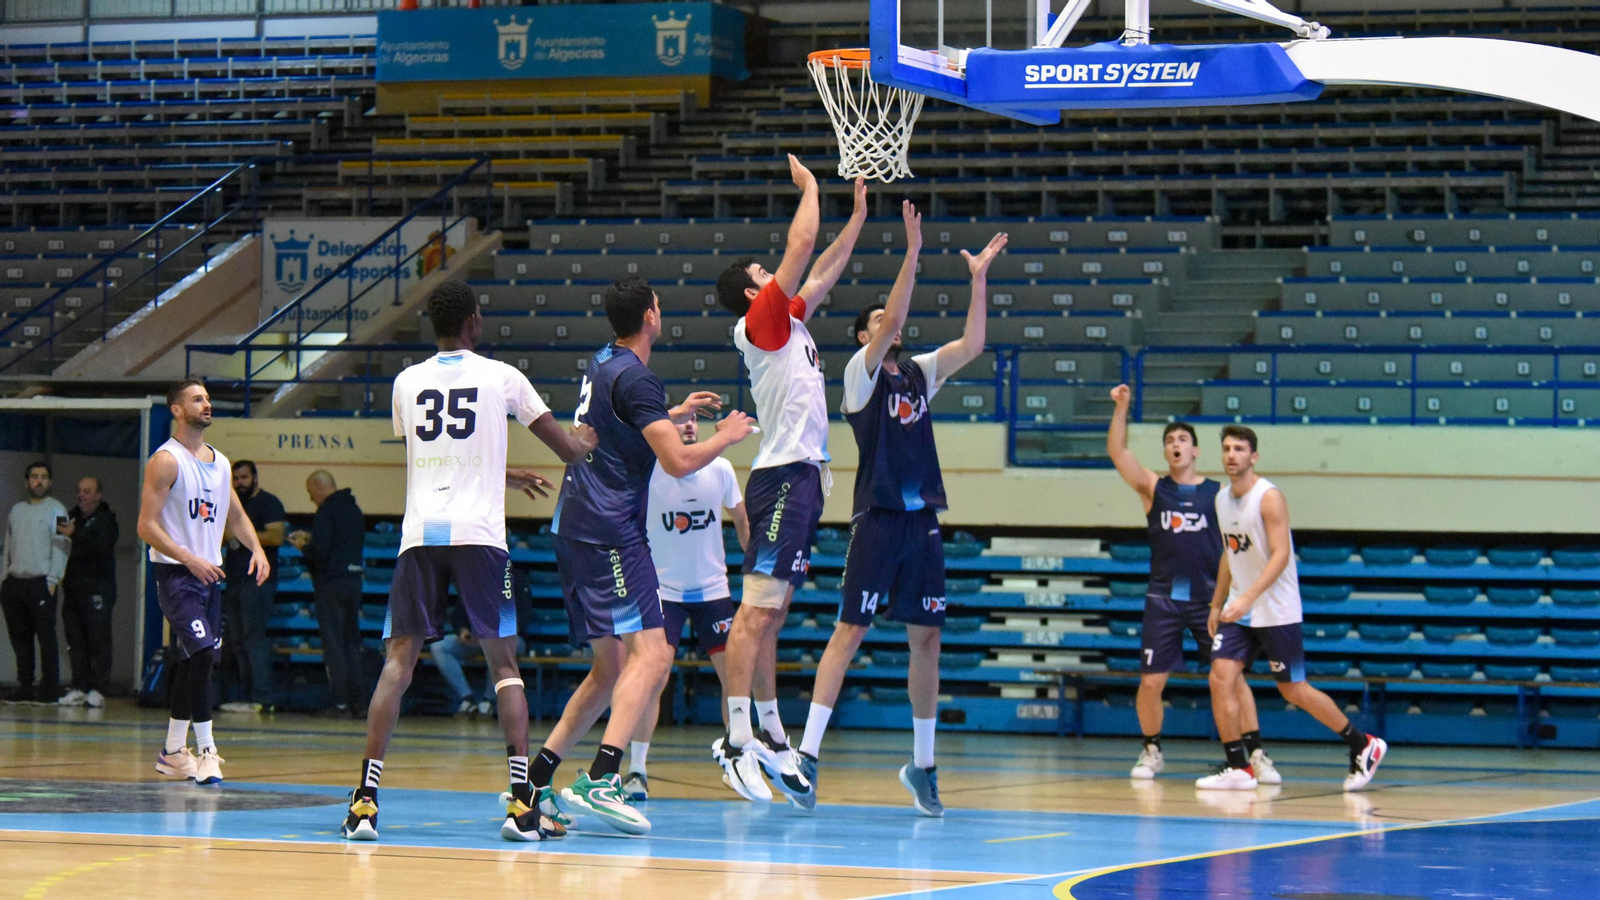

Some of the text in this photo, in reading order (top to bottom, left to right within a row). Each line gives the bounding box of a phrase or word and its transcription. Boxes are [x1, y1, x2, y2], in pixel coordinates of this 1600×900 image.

[534, 36, 606, 49] Ayuntamiento
[393, 51, 449, 66] Algeciras
[548, 48, 605, 62] Algeciras
[415, 387, 478, 441] 35
[278, 433, 355, 449] PRENSA
[661, 509, 716, 534] UDEA
[1160, 510, 1208, 533] UDEA
[861, 591, 879, 614] 14
[922, 597, 946, 613] UDE
[191, 619, 206, 639] 9
[1144, 648, 1154, 666] 7
